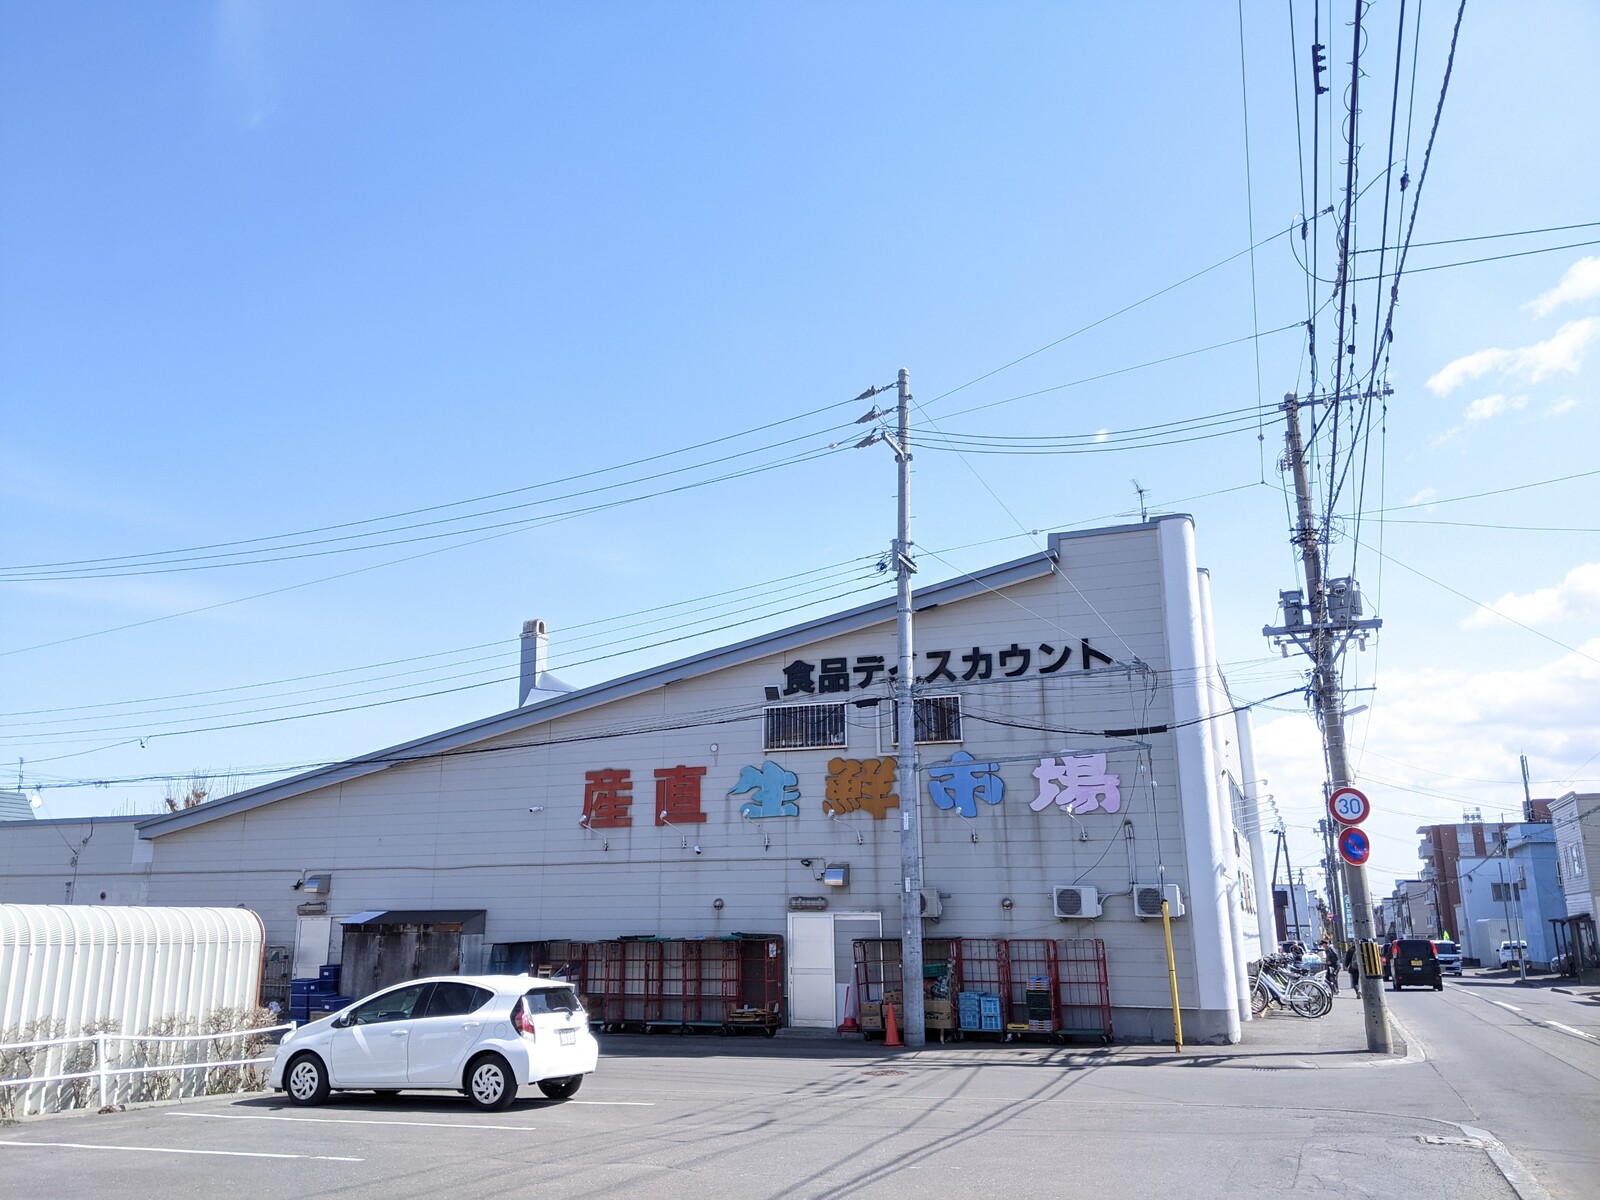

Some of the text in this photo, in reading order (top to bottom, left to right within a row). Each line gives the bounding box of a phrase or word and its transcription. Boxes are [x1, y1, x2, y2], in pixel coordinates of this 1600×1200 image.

[782, 638, 1113, 696] 食品デスカウント
[1338, 798, 1361, 814] 30
